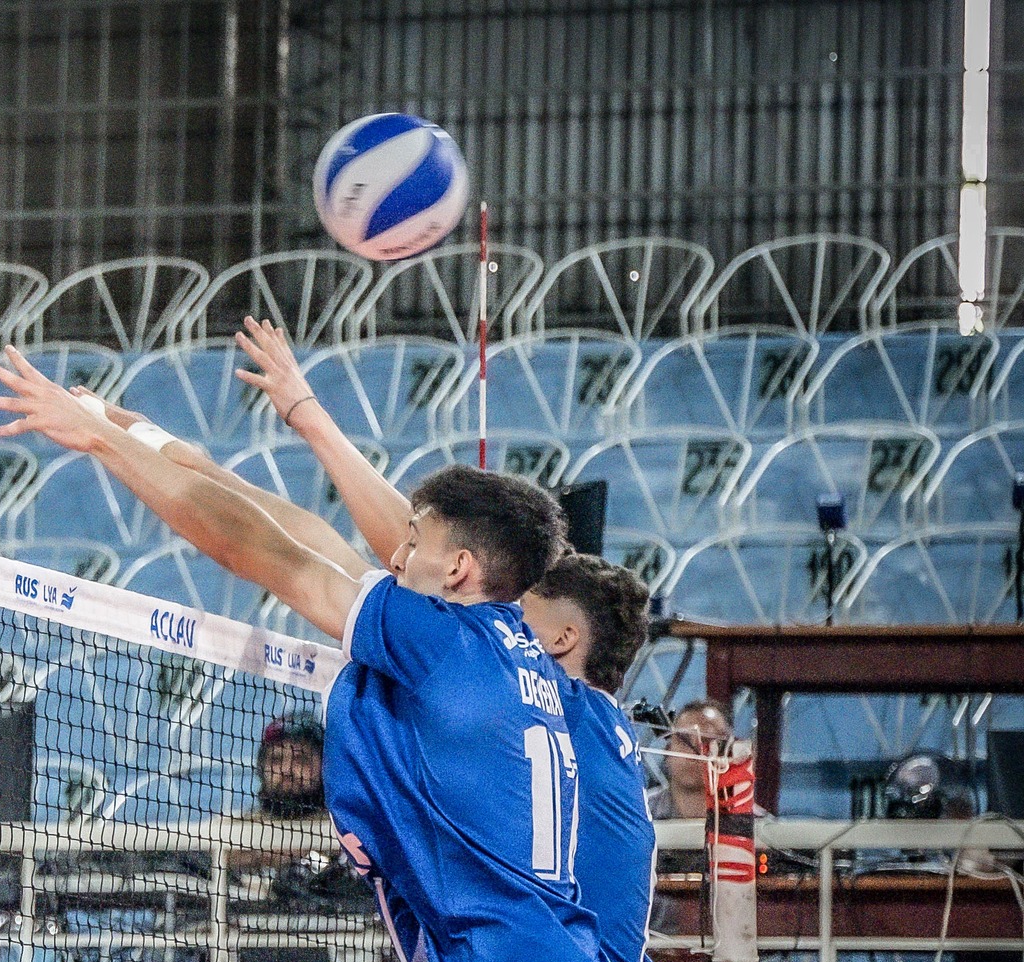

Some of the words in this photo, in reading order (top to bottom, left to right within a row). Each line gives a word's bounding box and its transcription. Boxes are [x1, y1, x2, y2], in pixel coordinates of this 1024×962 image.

[15, 574, 38, 599] RUS
[150, 608, 196, 649] ACLAV
[265, 644, 283, 667] RUS
